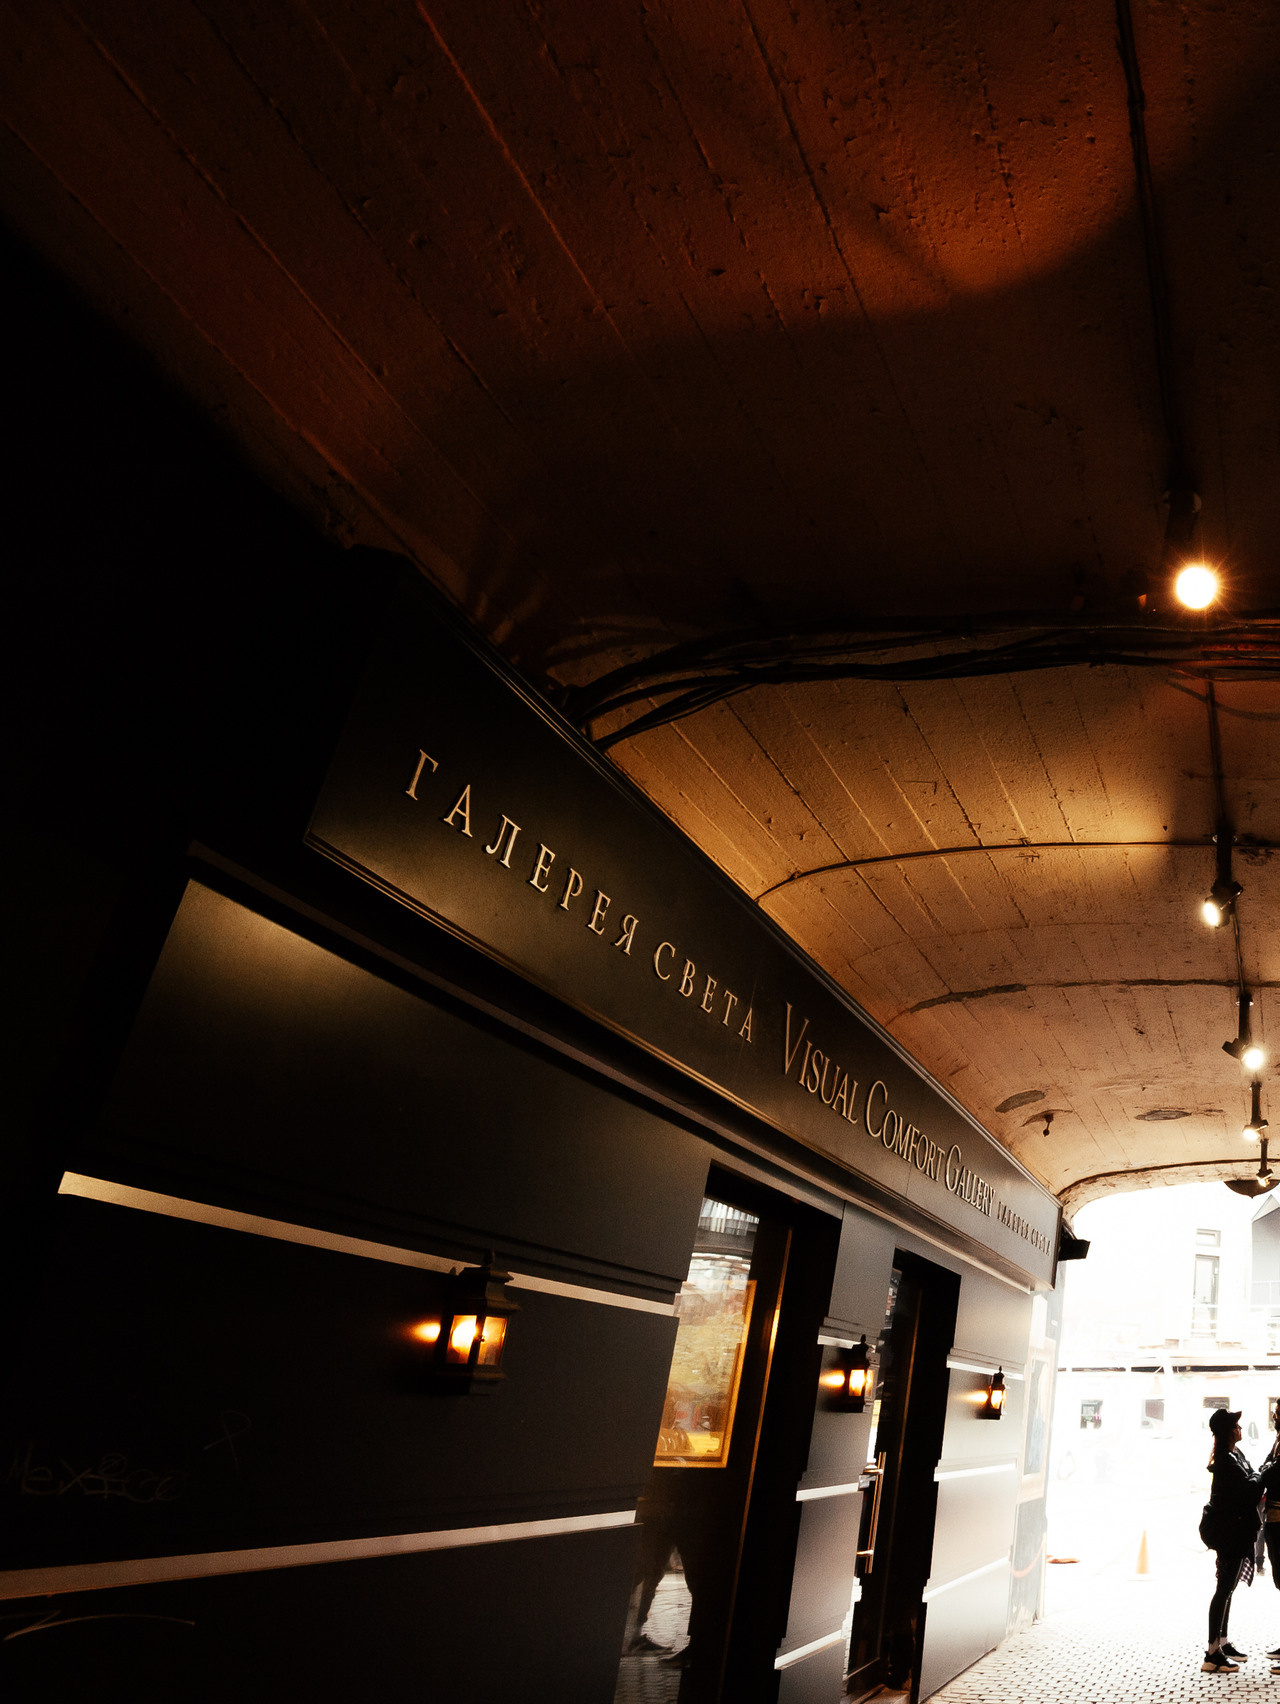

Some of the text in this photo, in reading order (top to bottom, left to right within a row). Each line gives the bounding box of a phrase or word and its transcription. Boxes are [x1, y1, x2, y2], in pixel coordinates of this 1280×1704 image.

[404, 748, 754, 1043] ГАЛЕРЕЯ СВЕТА
[783, 1001, 859, 1125] VISUAL
[864, 1080, 946, 1183] COMFORT
